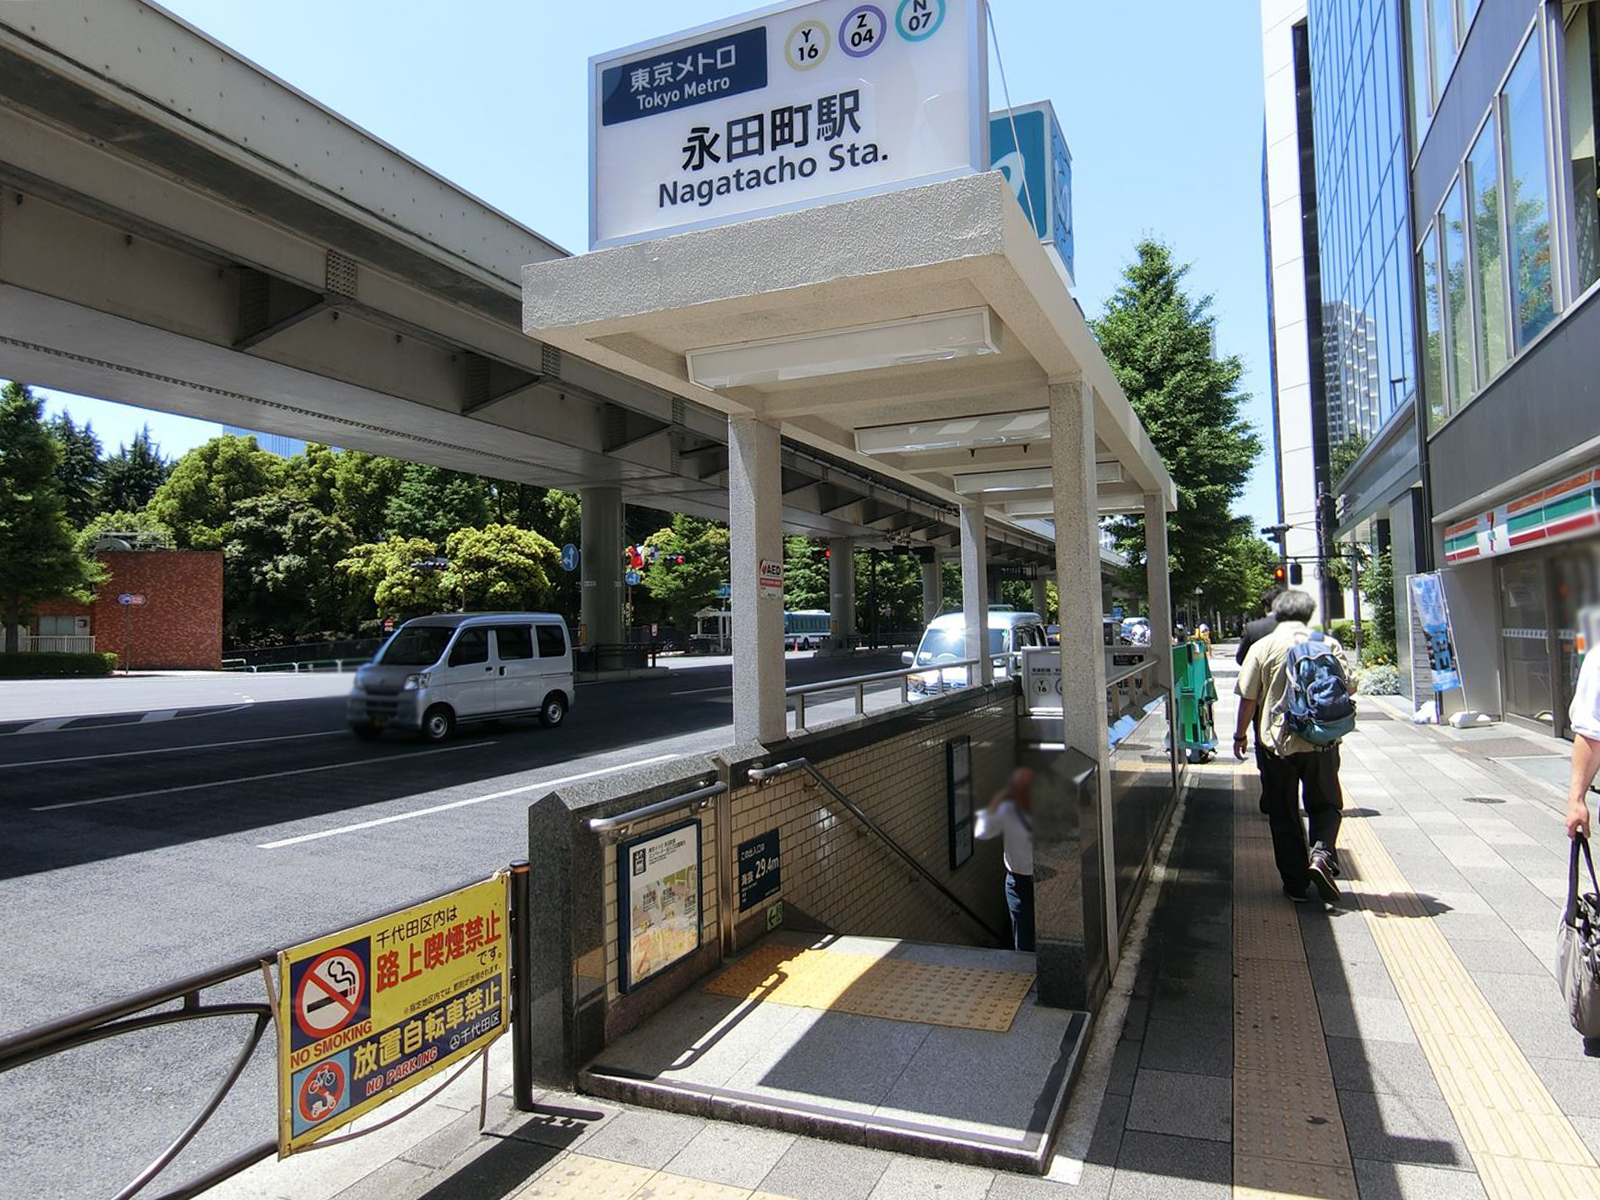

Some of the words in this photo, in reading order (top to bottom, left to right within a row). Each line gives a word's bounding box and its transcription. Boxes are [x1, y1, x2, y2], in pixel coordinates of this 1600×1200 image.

[857, 14, 867, 28] Z
[908, 12, 932, 31] 07
[913, 0, 927, 13] N
[798, 44, 818, 61] 16
[801, 29, 812, 43] Y
[850, 29, 874, 47] 04
[629, 44, 736, 92] 東京メトロ
[636, 87, 681, 111] Tokyo
[684, 75, 730, 99] Metro
[681, 88, 861, 172] 永田町駅
[658, 156, 817, 208] Nagatacho
[829, 140, 889, 172] Sta.
[767, 564, 781, 575] AED
[755, 857, 780, 879] 29.4m
[376, 906, 458, 949] 千代田区内は
[376, 909, 502, 993] 路上喫煙禁止
[477, 946, 503, 967] です。
[353, 982, 501, 1081] 放置自転車禁止
[461, 1011, 501, 1044] 千代田区
[291, 1047, 310, 1069] NO
[313, 1020, 372, 1058] SMOKING
[366, 1073, 383, 1097] NO
[386, 1046, 438, 1084] PARKING
